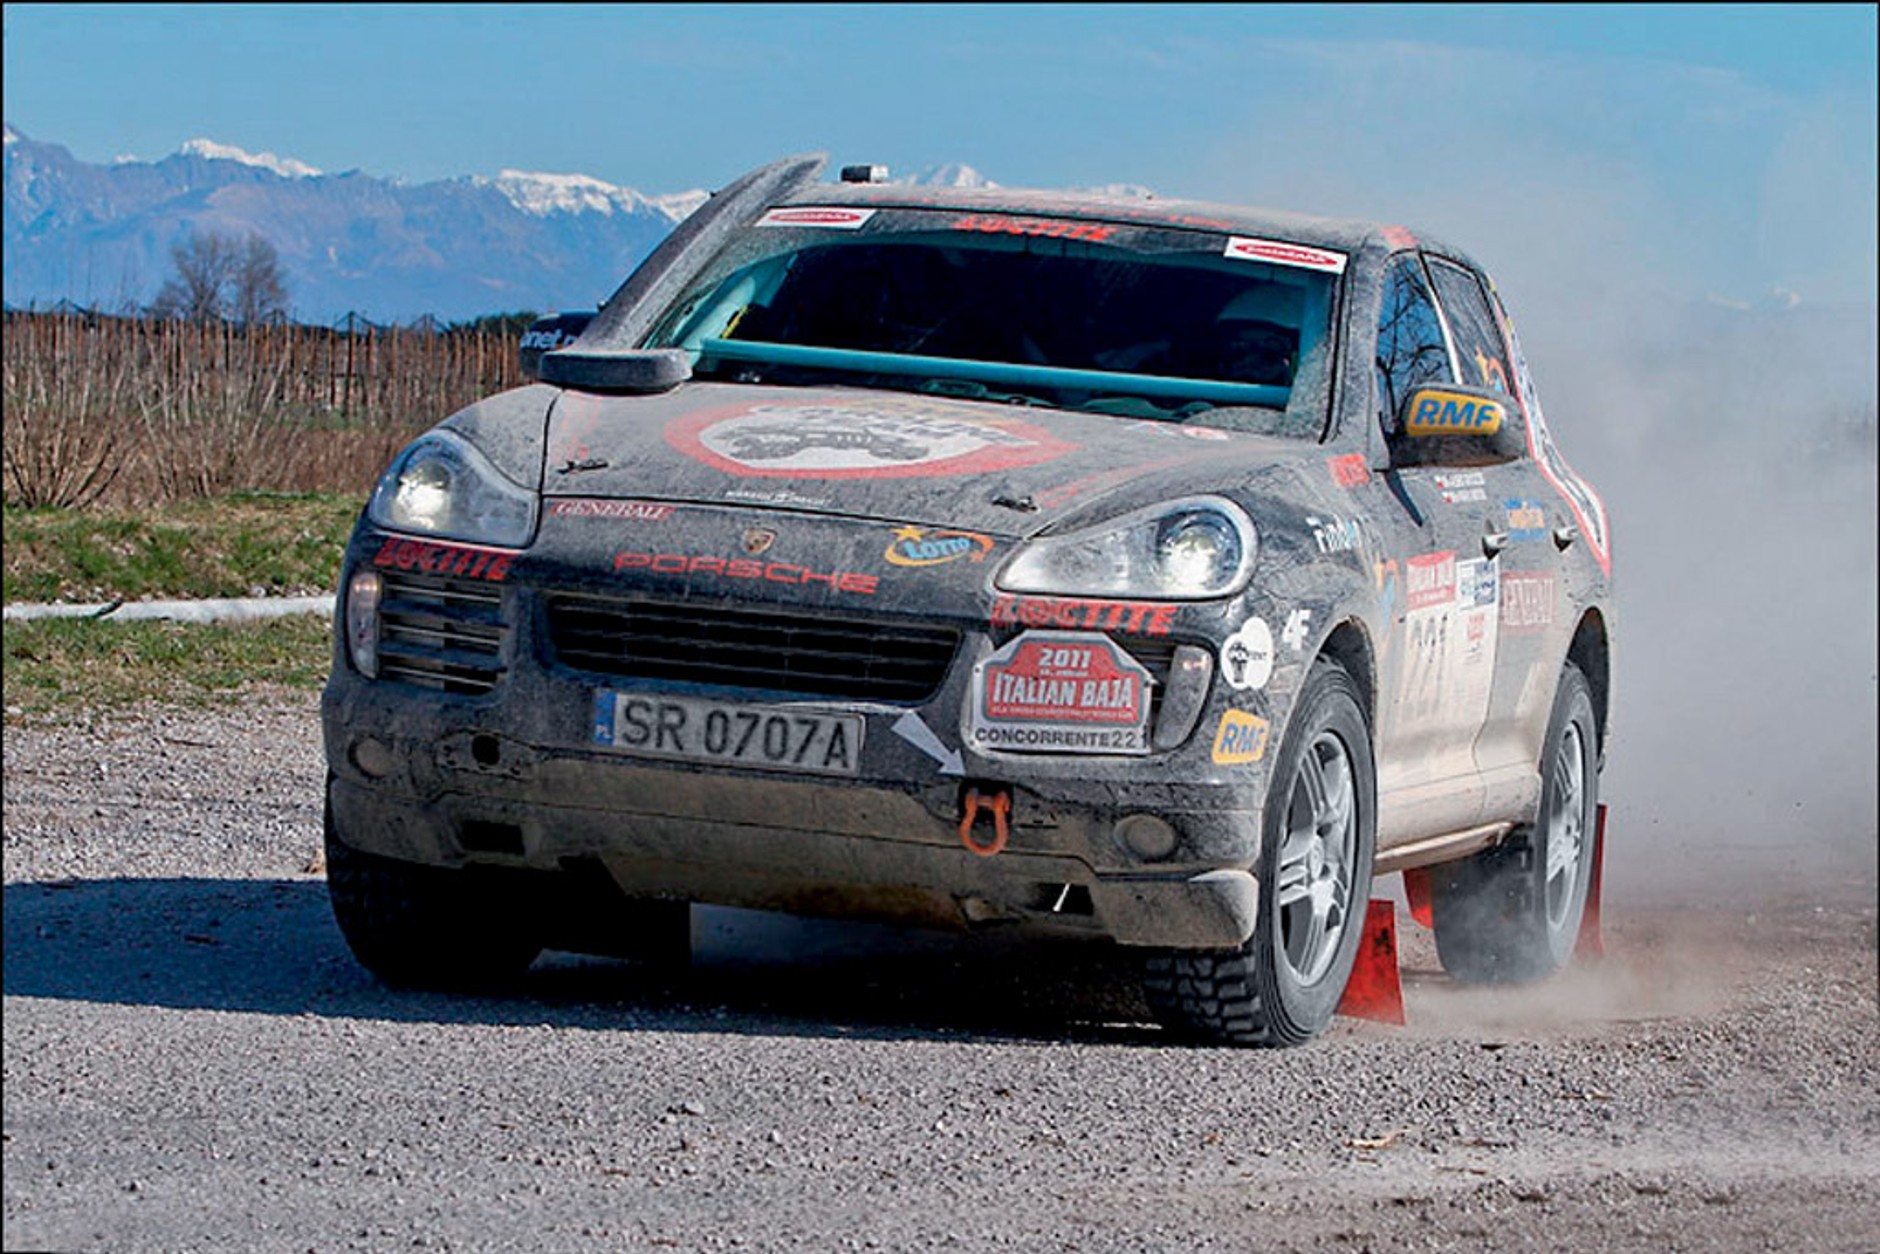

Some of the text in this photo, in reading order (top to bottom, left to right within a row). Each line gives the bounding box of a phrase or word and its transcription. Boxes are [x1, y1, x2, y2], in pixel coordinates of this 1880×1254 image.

[1414, 399, 1495, 427] RMF
[555, 502, 665, 519] GENERALI
[373, 536, 518, 581] LOCTITE
[904, 537, 970, 559] LOTTO
[614, 552, 880, 594] PORSCHE
[991, 594, 1177, 635] LOCTITE
[1039, 649, 1092, 668] 2011
[993, 672, 1132, 709] ITALIAN BAJA
[622, 700, 850, 769] SR 0707A
[974, 728, 1109, 748] CONCORRENTE
